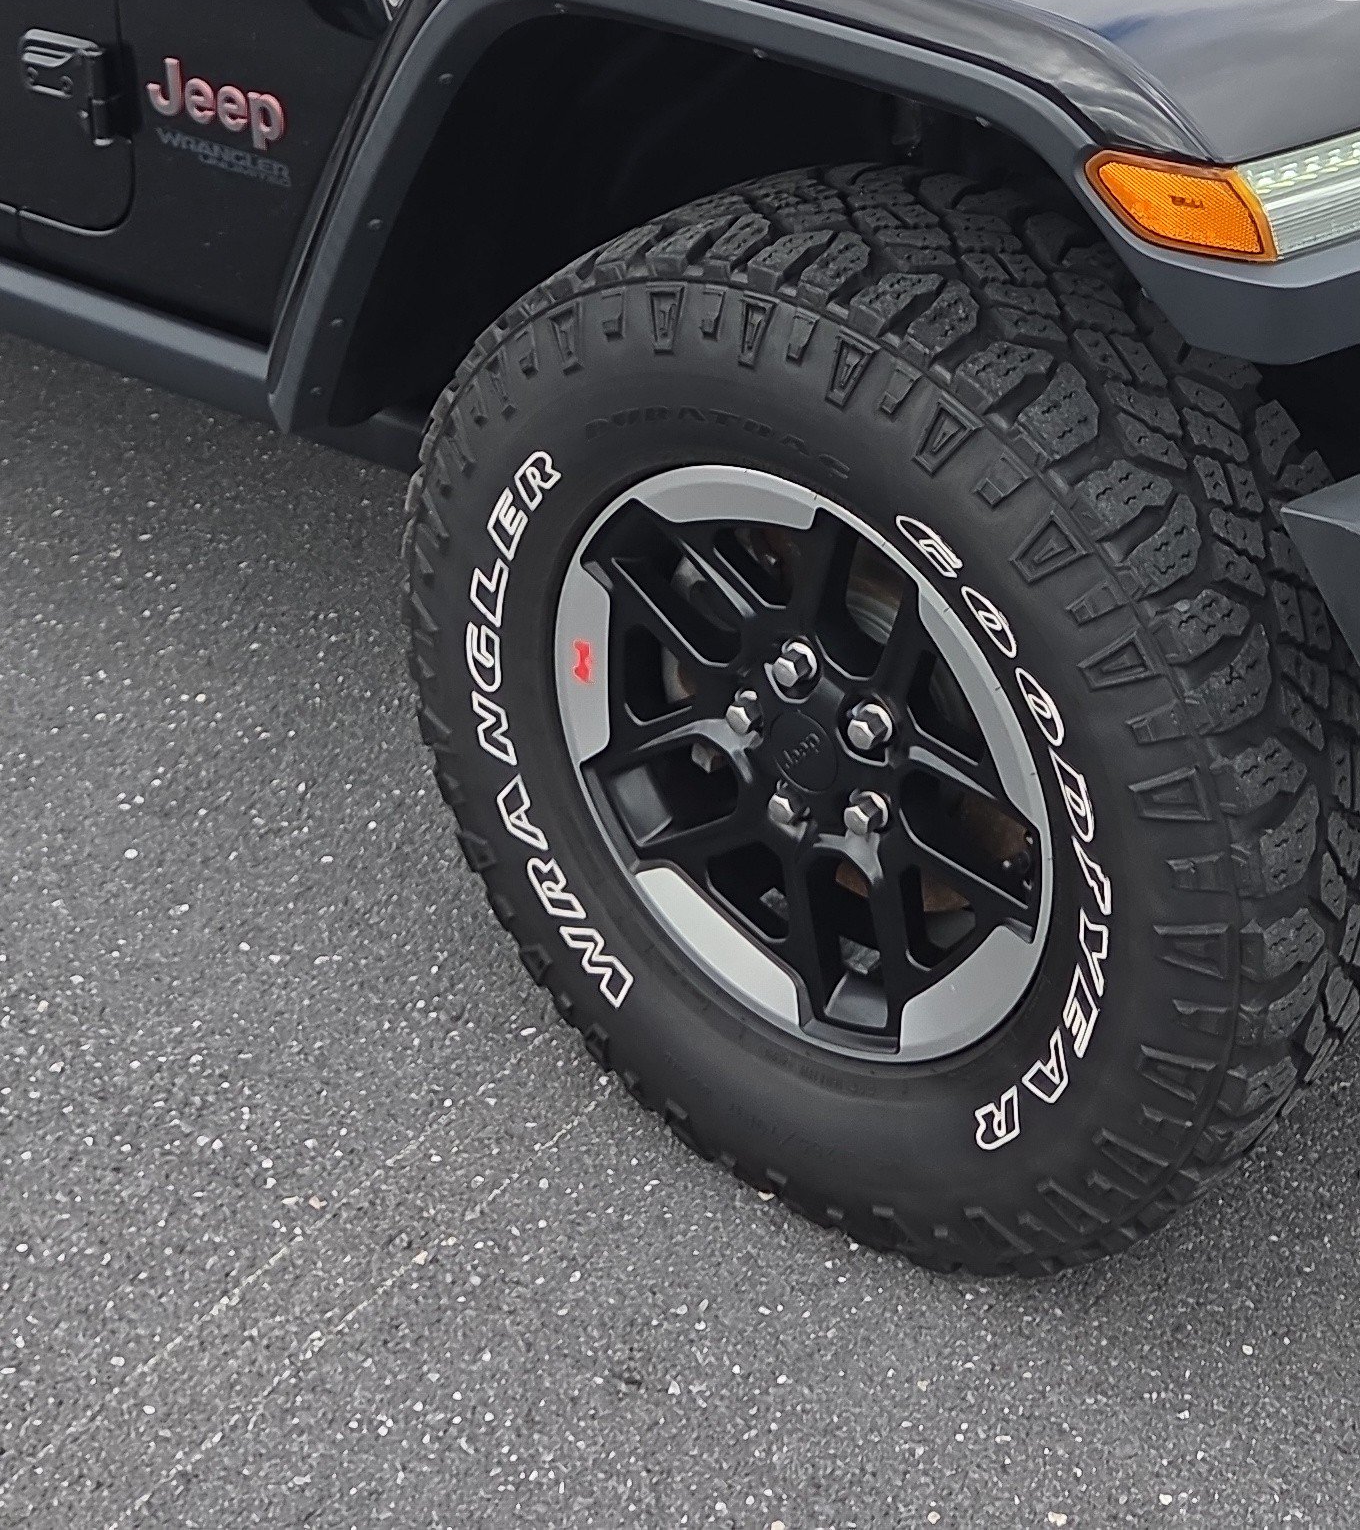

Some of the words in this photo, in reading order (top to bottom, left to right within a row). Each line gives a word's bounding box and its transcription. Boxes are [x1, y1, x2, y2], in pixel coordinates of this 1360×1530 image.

[146, 57, 285, 151] Jeep
[464, 451, 635, 1010] WRANGLER
[896, 515, 1112, 1150] GOODYEAR
